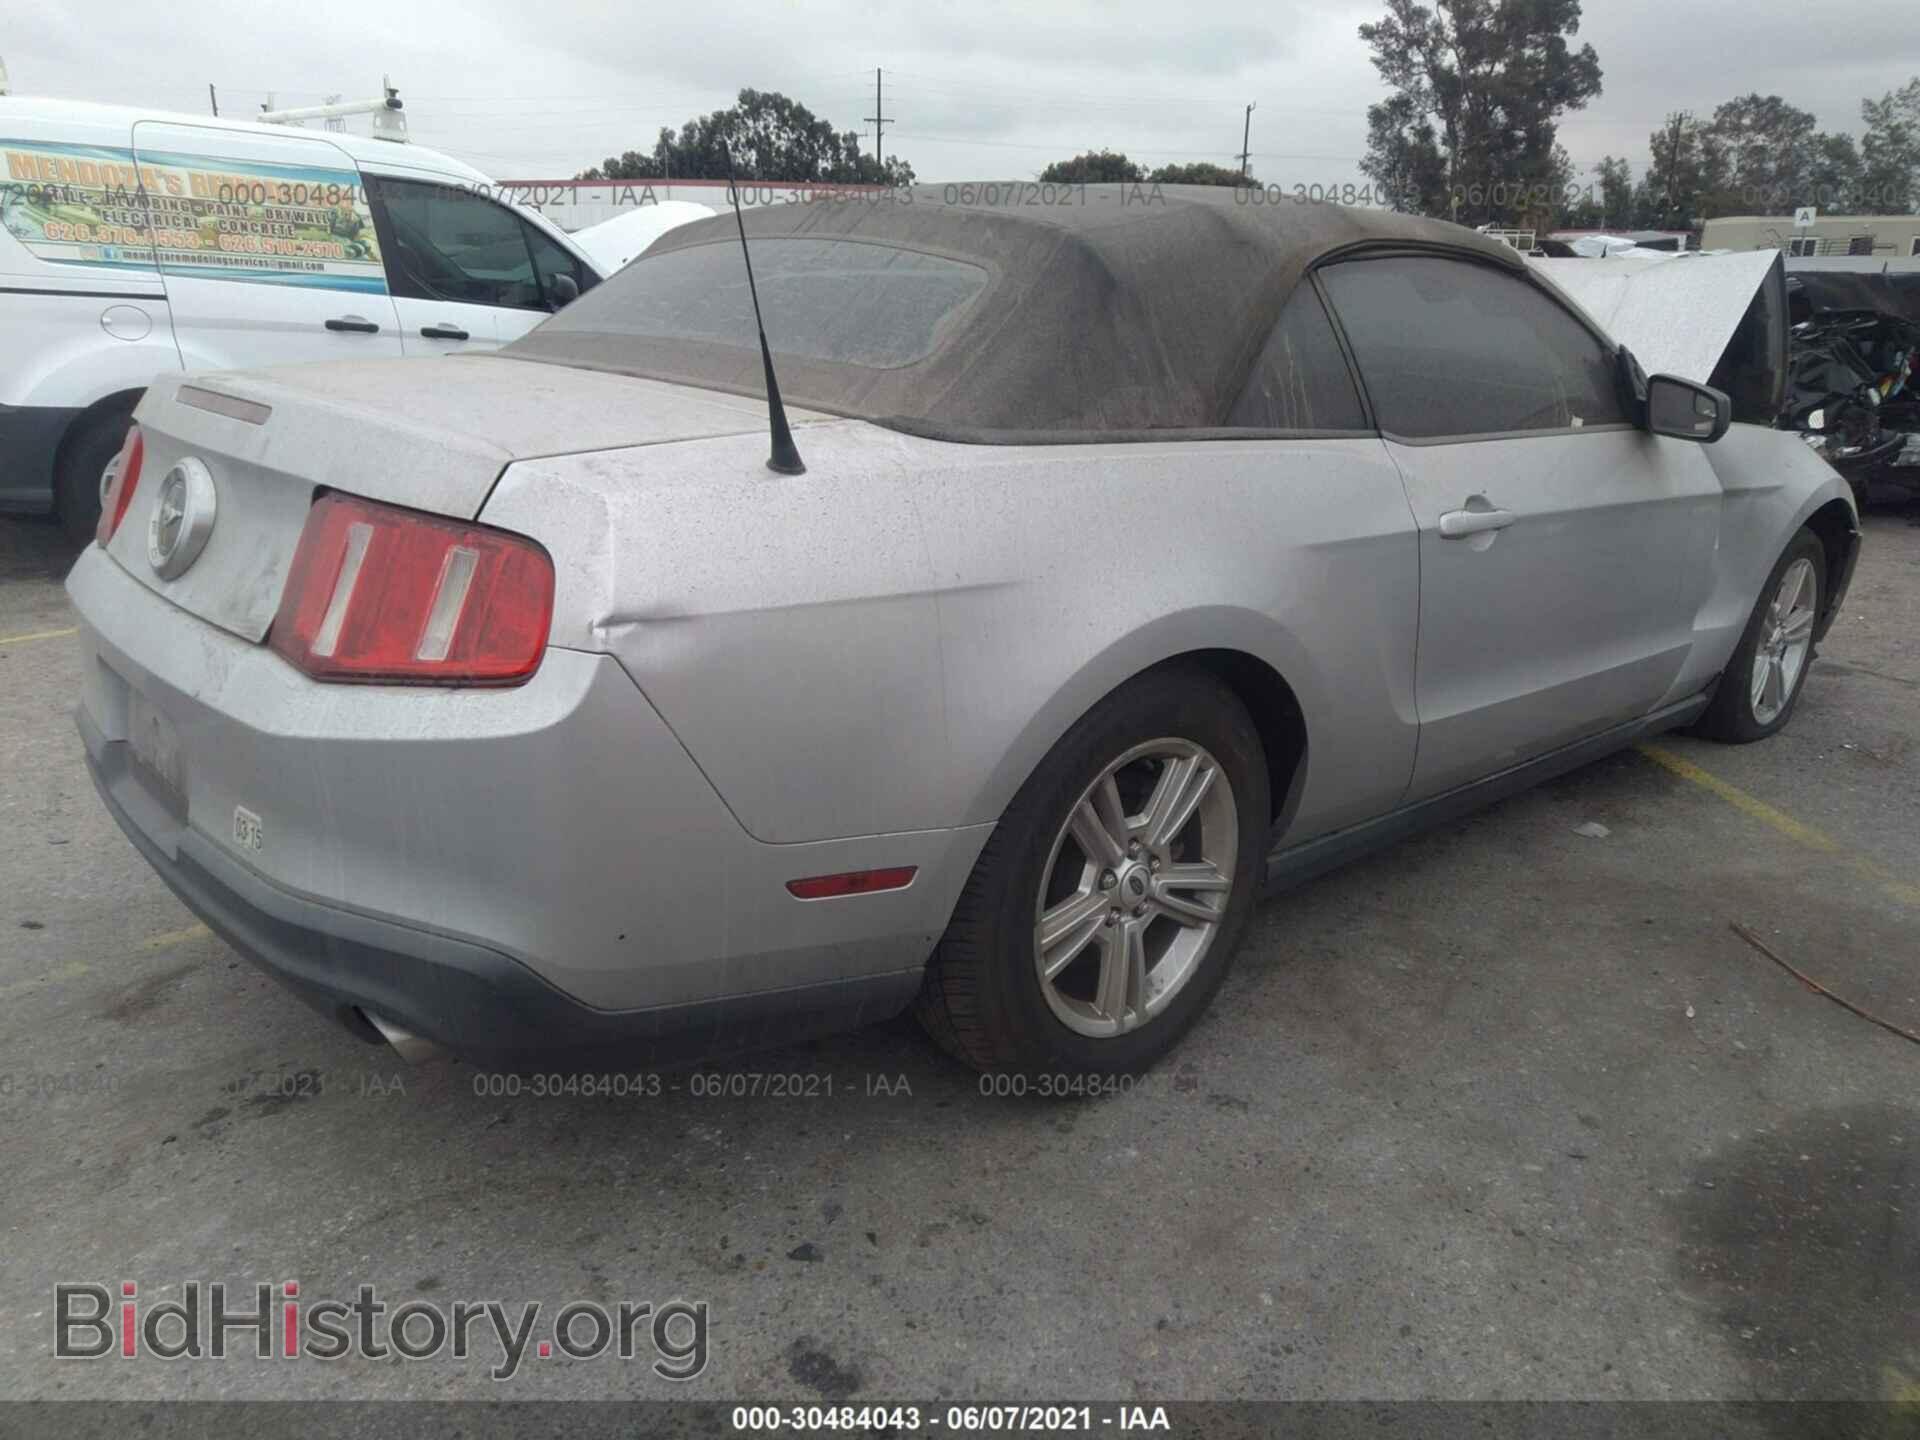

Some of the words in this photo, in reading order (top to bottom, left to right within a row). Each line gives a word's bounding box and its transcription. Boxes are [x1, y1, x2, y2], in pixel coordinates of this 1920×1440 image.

[207, 203, 249, 218] PAINT
[1799, 210, 1810, 222] A
[103, 211, 200, 228] ELECTRICAL
[218, 219, 296, 236] CONCRETE
